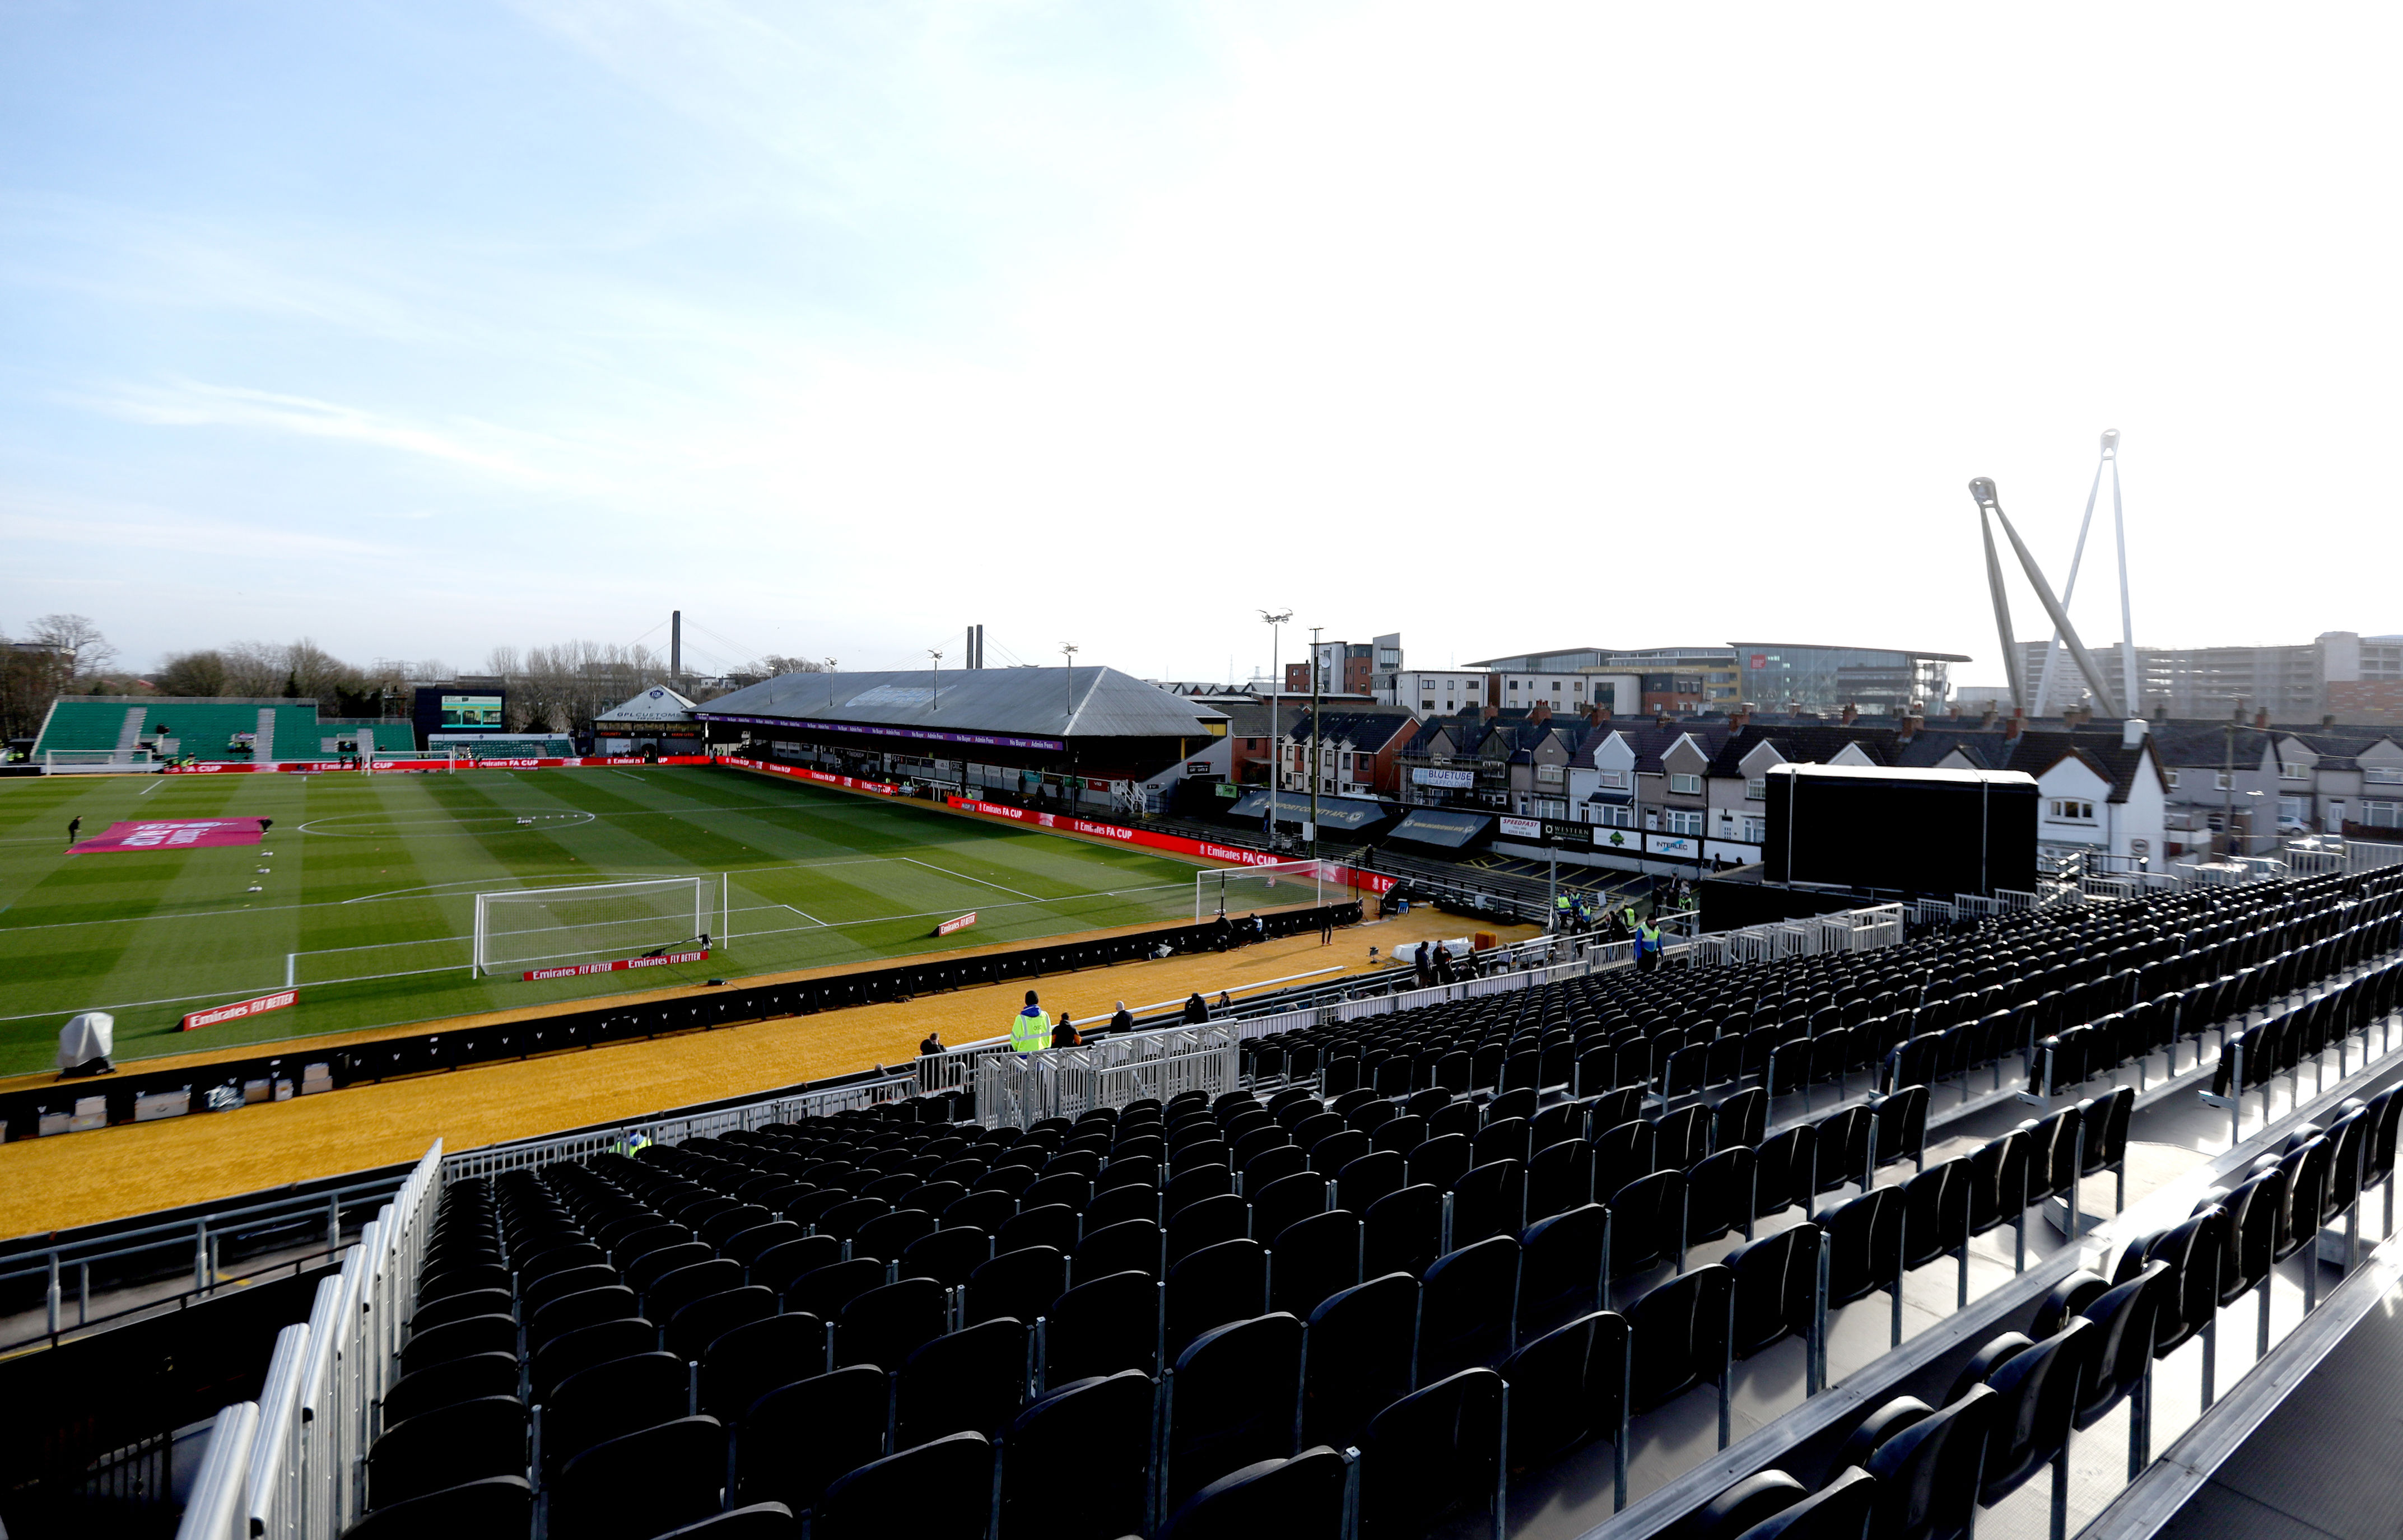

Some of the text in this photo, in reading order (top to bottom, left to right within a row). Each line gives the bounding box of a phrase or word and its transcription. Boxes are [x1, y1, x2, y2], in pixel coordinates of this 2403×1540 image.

[1429, 770, 1472, 780] BLUETUBE
[982, 804, 1022, 819] Emirates FA CUP
[1503, 818, 1538, 827] SPEEDFAST
[1106, 827, 1115, 837] FA
[1116, 828, 1132, 839] CUP
[1554, 825, 1589, 835] WESTERN
[1656, 841, 1688, 850] INTERLEC
[1207, 845, 1278, 865] Emirates FA CUP
[941, 922, 960, 934] Emirates
[628, 952, 700, 969] Emirates FLY BETTER
[532, 962, 612, 980] Emirates FLY BETTER
[189, 992, 295, 1028] Emirates FLY BETTER
